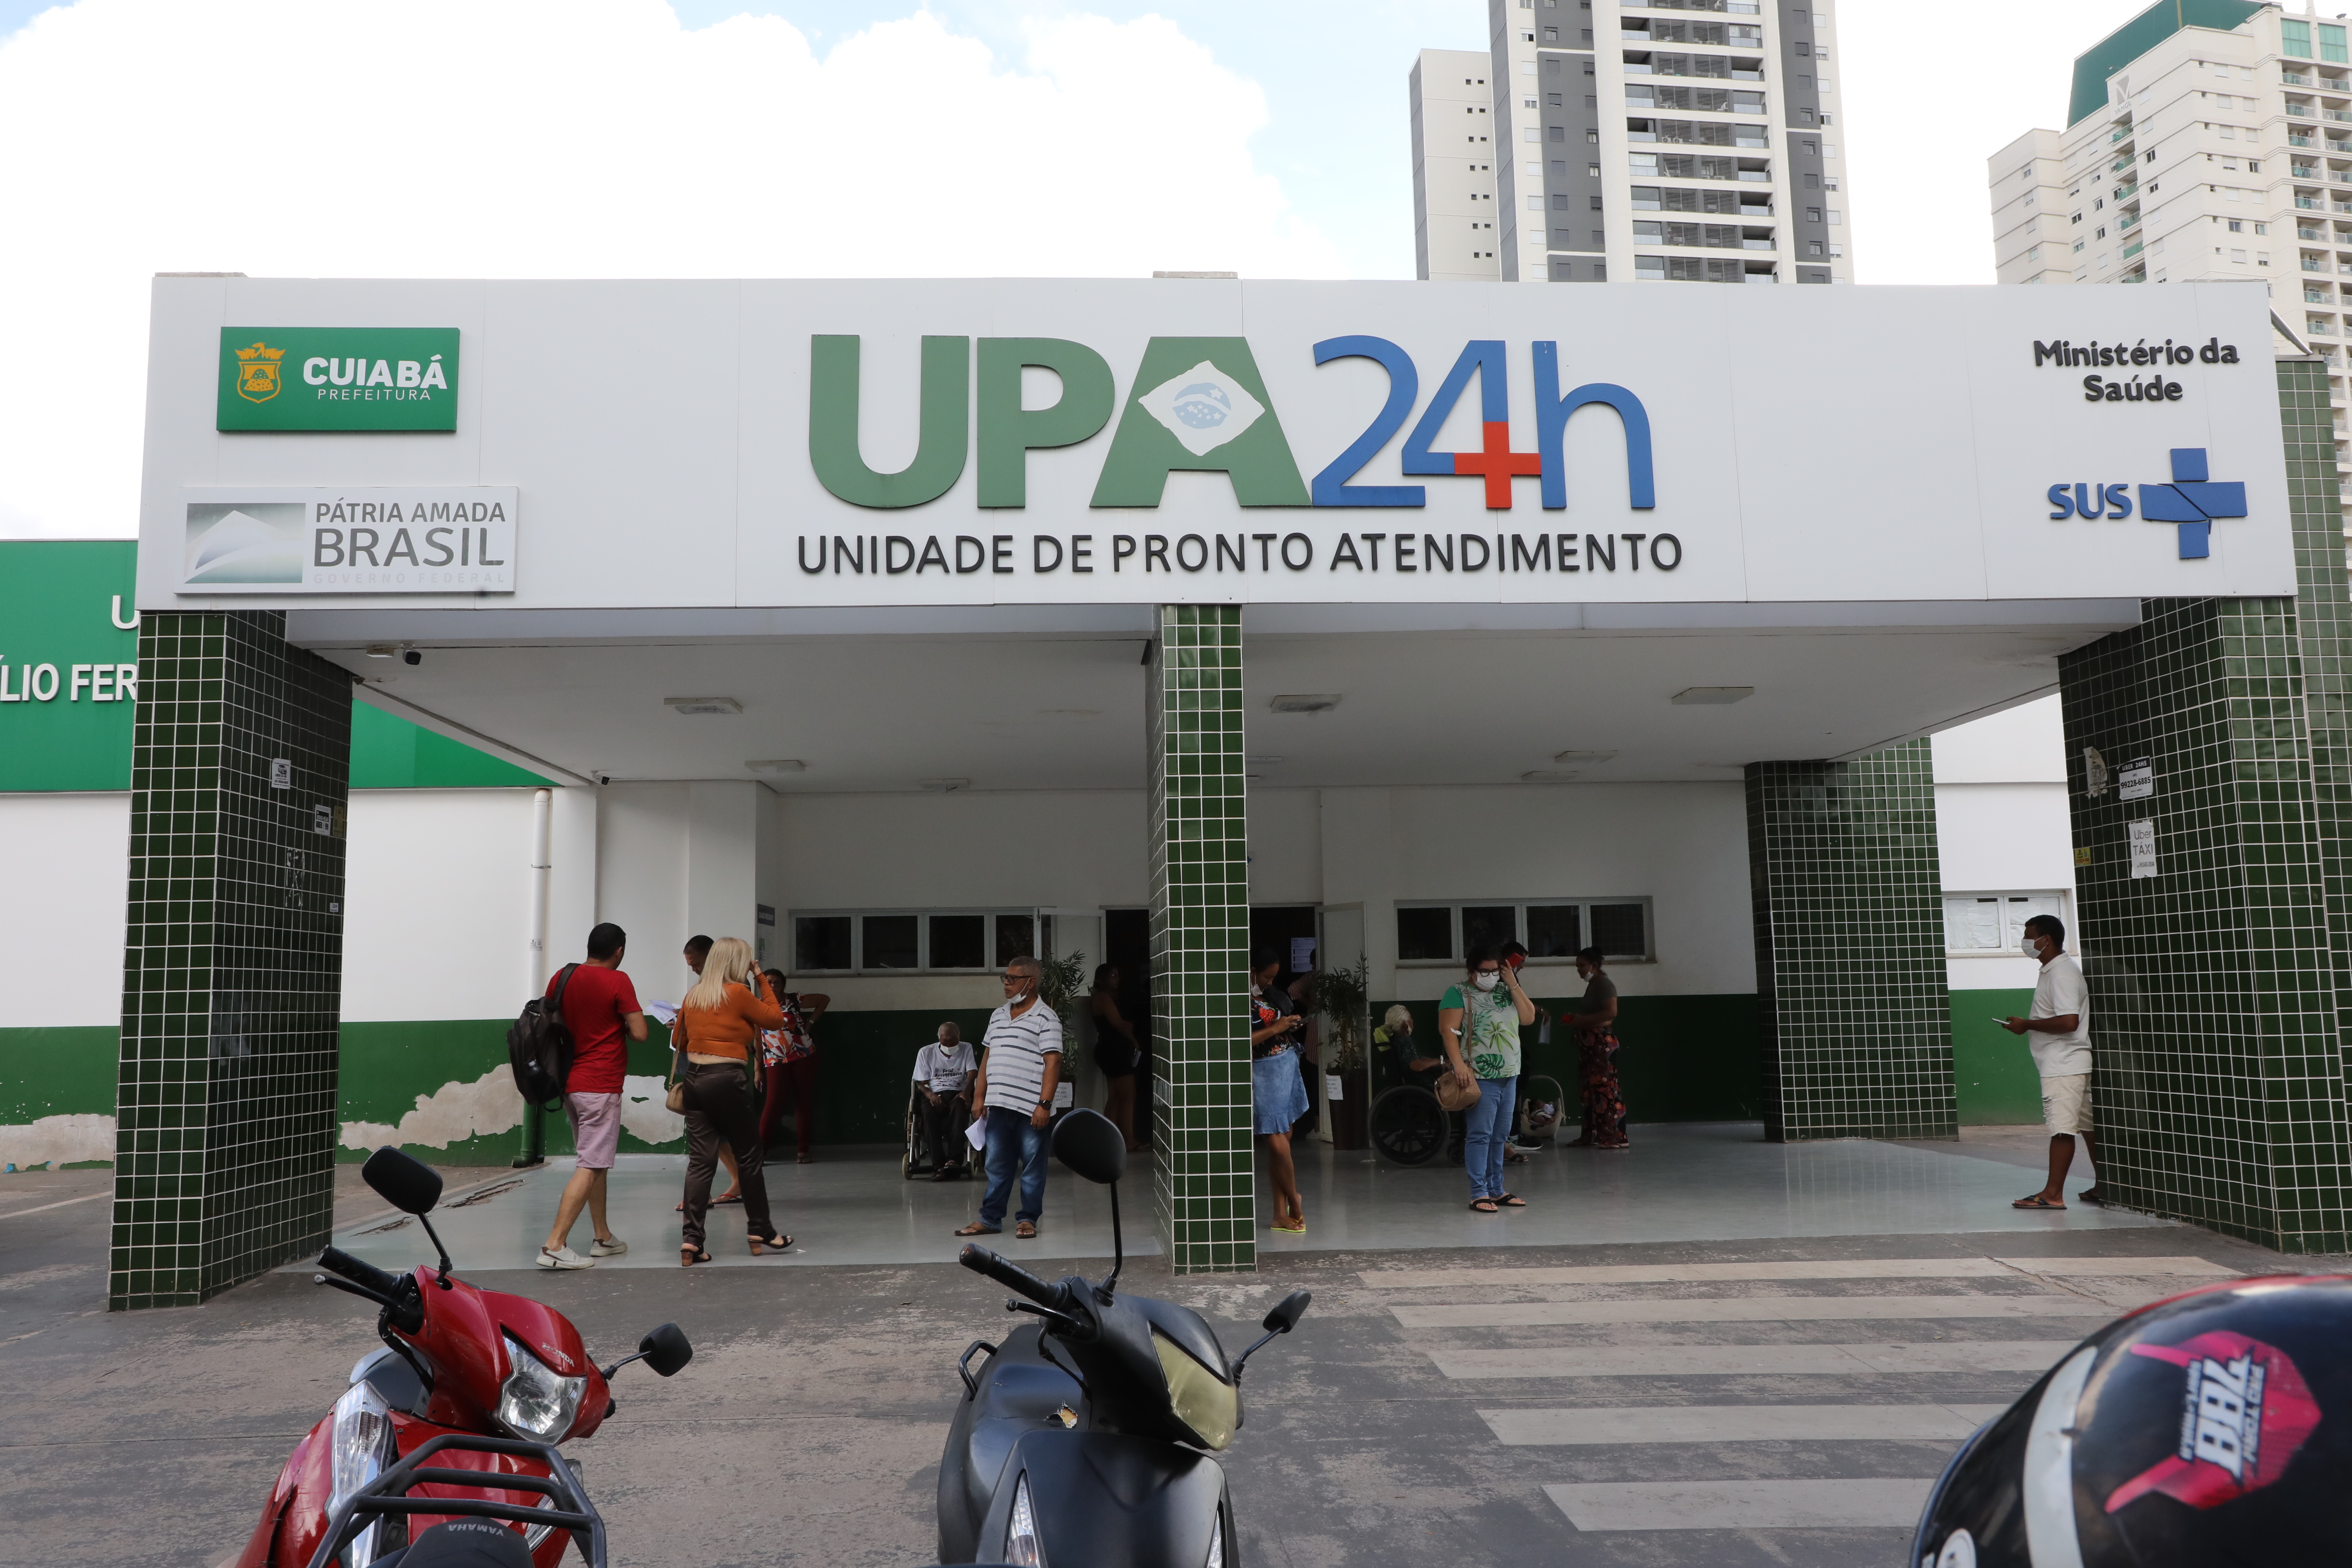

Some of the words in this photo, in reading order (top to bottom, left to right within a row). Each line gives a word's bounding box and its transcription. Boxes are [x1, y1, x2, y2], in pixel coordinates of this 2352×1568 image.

[2033, 338, 2194, 366] Ministério
[2200, 337, 2240, 364] da
[303, 354, 448, 389] CUIABÁ
[318, 389, 431, 400] PREFEITURA
[2083, 374, 2183, 401] Saúde
[316, 497, 404, 523] PÁTRIA
[410, 502, 506, 523] AMADA
[2047, 483, 2133, 519] SUS
[314, 527, 505, 567] BRASIL
[798, 535, 1014, 574] UNIDADE
[1034, 535, 1093, 573] DE
[1113, 533, 1314, 573] PRONTO
[1330, 533, 1682, 572] ATENDIMENTO
[314, 573, 406, 584] GOVERNO
[418, 572, 505, 584] FEDERAL
[2120, 776, 2151, 789] 99228-6885
[2133, 829, 2152, 840] Uber
[2133, 841, 2153, 856] TÁXI
[448, 1524, 504, 1536] YAMAHA
